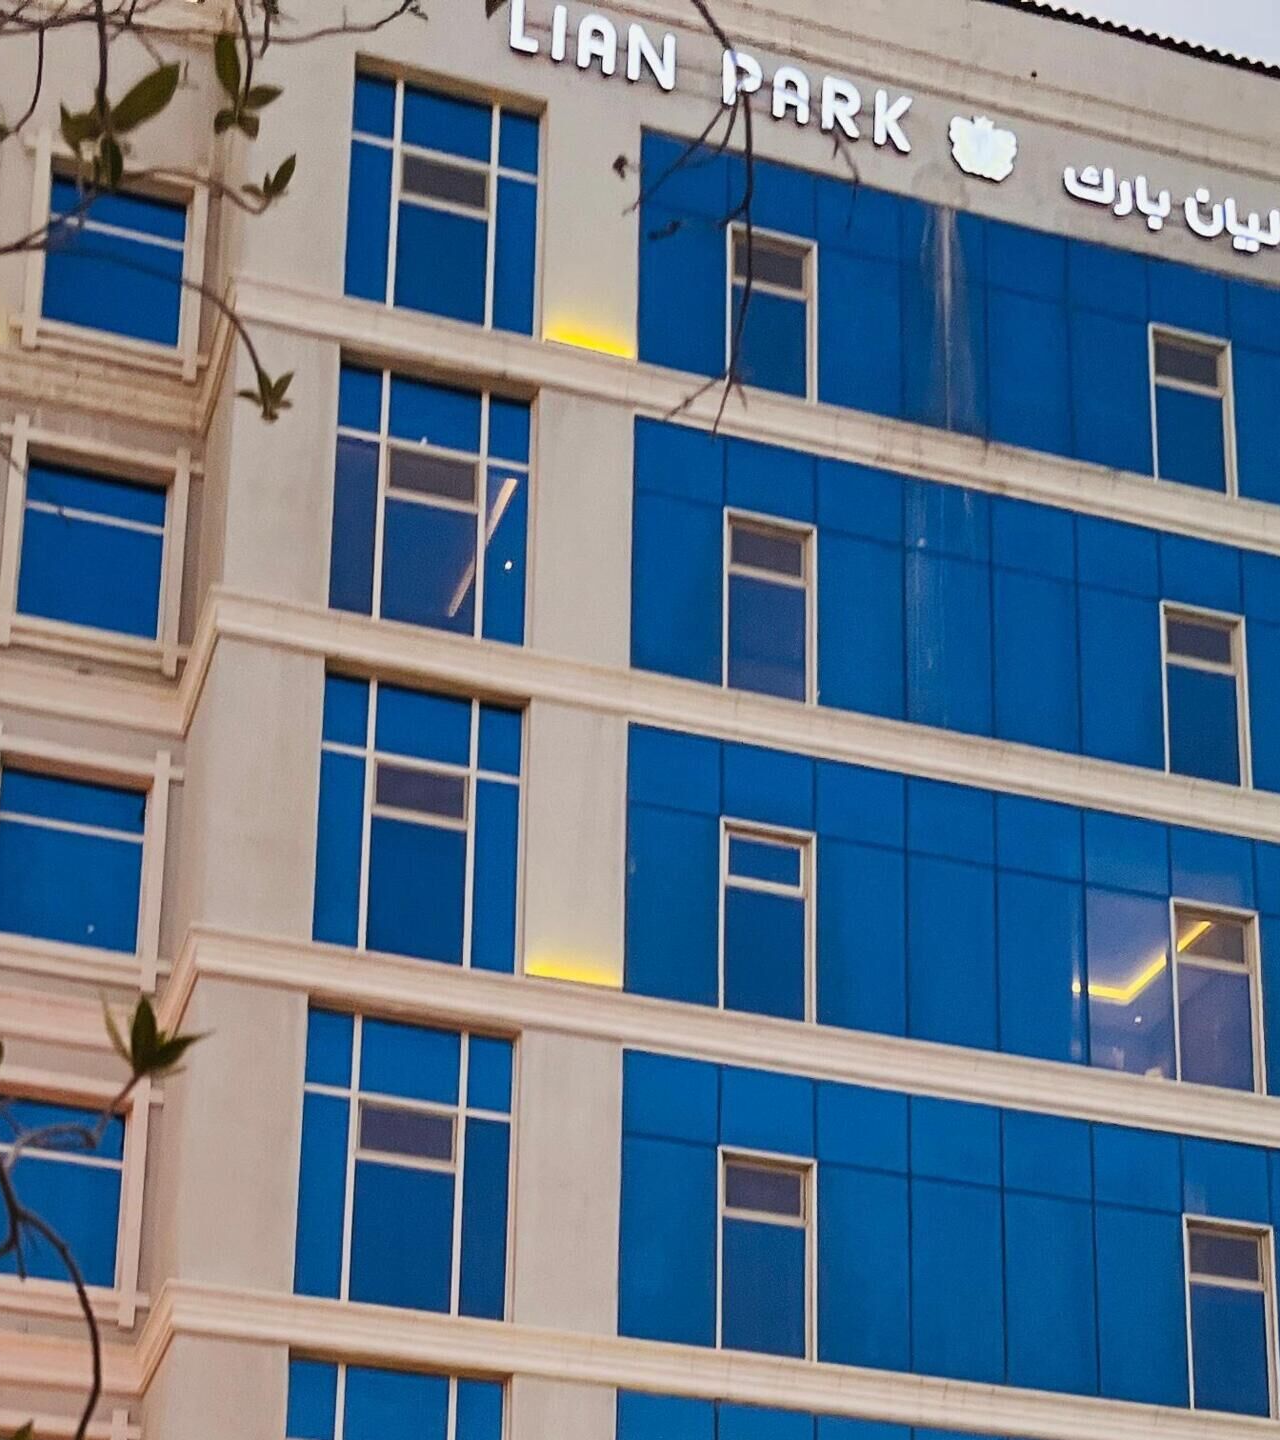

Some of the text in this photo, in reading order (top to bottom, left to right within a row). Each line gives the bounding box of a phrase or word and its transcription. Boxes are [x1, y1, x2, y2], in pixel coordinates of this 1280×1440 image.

[509, 0, 914, 153] LIAN PARK
[1062, 165, 1172, 231] بارك
